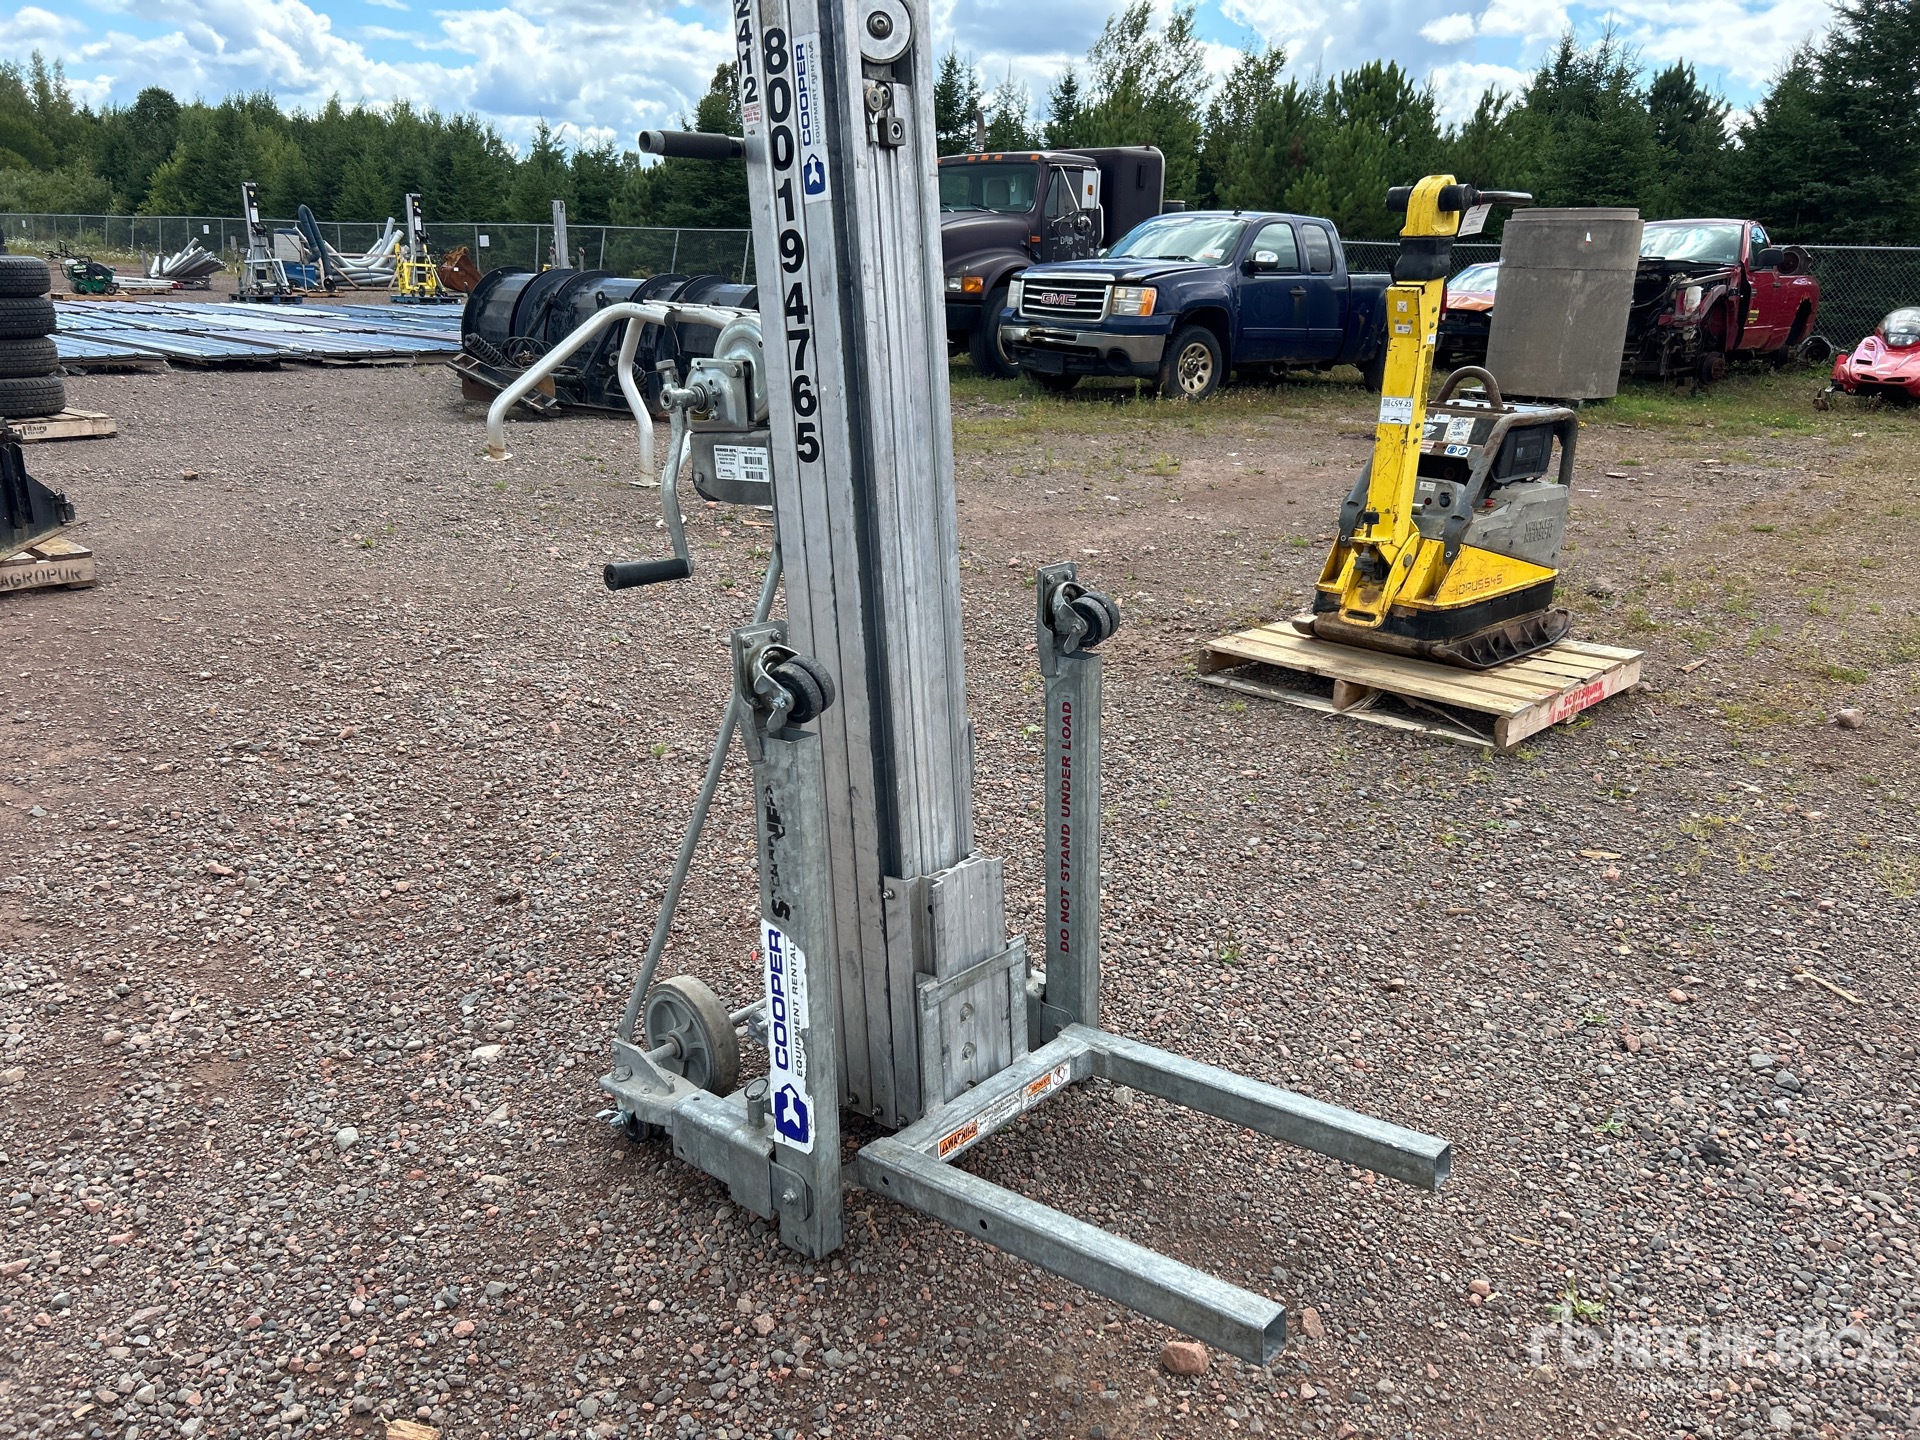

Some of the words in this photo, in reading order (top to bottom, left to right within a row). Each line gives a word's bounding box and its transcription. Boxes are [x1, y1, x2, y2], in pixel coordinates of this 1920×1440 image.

[808, 41, 818, 84] RENTALS
[795, 43, 812, 147] COOPER
[811, 85, 821, 145] EQUIPMENT
[764, 27, 820, 463] 800194765
[1041, 292, 1077, 306] GMC
[1061, 701, 1072, 750] LOAD
[1061, 755, 1072, 818] UNDER
[1060, 823, 1071, 883] STAND
[1060, 886, 1070, 924] NOT
[1059, 931, 1070, 953] DO
[768, 928, 789, 1071] COOPER
[791, 998, 803, 1077] EQUIPMENT
